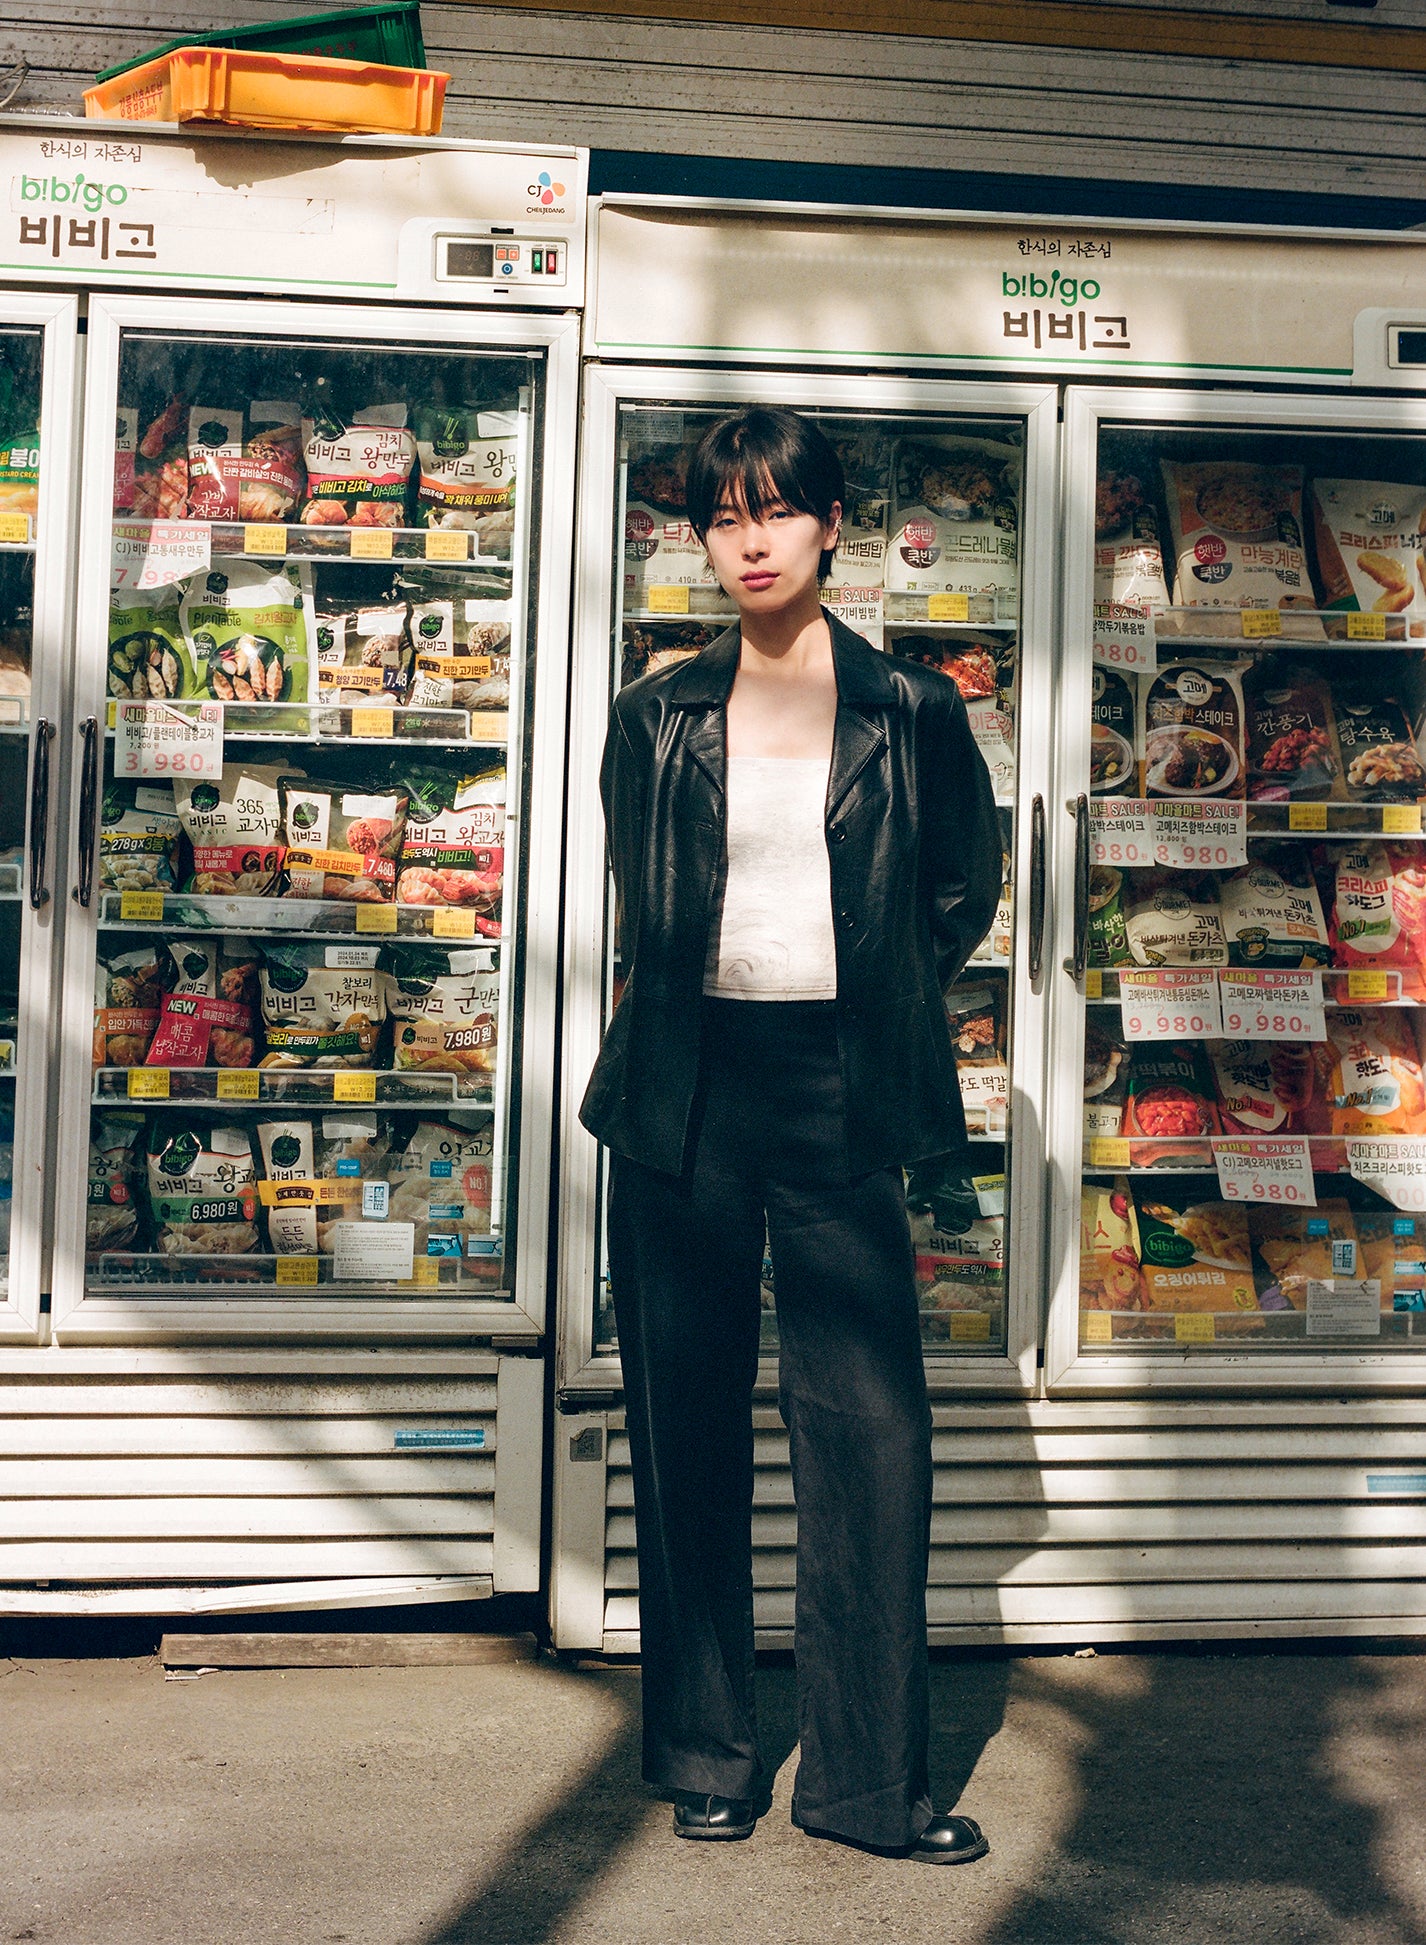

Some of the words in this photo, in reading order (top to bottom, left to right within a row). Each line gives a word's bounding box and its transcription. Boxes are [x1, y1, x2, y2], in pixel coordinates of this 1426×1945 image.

[40, 141, 87, 160] 한식의
[95, 144, 142, 163] 자존심
[21, 173, 128, 213] bibigo
[527, 185, 542, 198] CJ
[526, 207, 566, 215] CHEILJEDANG
[19, 215, 157, 261] 비비고
[1016, 238, 1061, 257] 한식의
[1067, 241, 1111, 259] 자존심
[1002, 269, 1101, 307] bibigo
[1003, 309, 1131, 351] 비비고
[375, 433, 403, 449] 김치
[436, 438, 466, 449] bibigo
[308, 444, 351, 462] 비비고
[360, 446, 410, 470] 왕만두
[431, 459, 477, 478] 비비고
[201, 490, 225, 505] 갈비
[1370, 509, 1396, 525] 고메
[113, 527, 150, 538] 새마을
[157, 528, 209, 542] 특가세일
[907, 525, 936, 542] 햇반
[1340, 531, 1398, 551] 크리스피
[907, 548, 936, 566] 쿡반
[1197, 543, 1223, 559] 햇반
[1200, 565, 1226, 580] 쿡반
[202, 595, 230, 606] 비비고
[843, 589, 880, 603] SALE!
[416, 641, 448, 653] 비비고
[460, 666, 490, 677] 고기만두
[351, 675, 381, 687] 고기만두
[1182, 679, 1207, 694] 고메
[1195, 709, 1235, 727] 스테이크
[1256, 712, 1314, 736] 깐풍기
[1340, 725, 1396, 746] 탕수육
[126, 753, 205, 774] 3,980
[236, 798, 264, 815] 365
[1111, 803, 1146, 817] SALE!
[1154, 802, 1203, 818] 새마을마트
[1205, 805, 1240, 819] SALE!
[189, 814, 227, 828] 비비고
[470, 812, 497, 828] 김치
[1156, 820, 1238, 836] 고메치즈함박스테이크
[1094, 843, 1139, 861] 980
[1156, 844, 1228, 865] 8,980
[314, 858, 330, 869] 진한
[330, 860, 361, 873] 김치만두
[367, 858, 394, 878] 7,480
[1346, 854, 1370, 870] 고메
[1338, 876, 1389, 895] 크리스피
[1287, 895, 1312, 914] 고메
[1092, 912, 1125, 934] 바삭한
[1193, 914, 1220, 930] 고메
[1284, 908, 1318, 926] 돈카츠
[1341, 919, 1367, 939] No.1
[1187, 930, 1224, 947] 돈카츠
[343, 977, 373, 989] 찰보리
[1123, 973, 1159, 984] 새마을
[1163, 973, 1212, 984] 특가세일
[1223, 973, 1258, 984] 새마을
[1263, 973, 1312, 985] 특가세일
[166, 999, 197, 1015] NEW
[265, 995, 317, 1013] 비비고
[396, 998, 444, 1014] 비비고
[1128, 1016, 1203, 1035] 9,980
[1228, 1013, 1303, 1034] 9,980
[1345, 1088, 1373, 1108] No.1
[1216, 1143, 1251, 1154] 새마을
[1257, 1144, 1304, 1155] 특가세일
[1350, 1143, 1400, 1159] 새마을마트
[164, 1154, 193, 1164] bibigo
[271, 1169, 306, 1180] 비비고
[157, 1178, 204, 1195] 비비고
[1225, 1182, 1298, 1200] 5,980
[191, 1200, 239, 1221] 6,980원
[930, 1238, 981, 1256] 비비고
[1148, 1239, 1190, 1254] bibigo
[1153, 1270, 1226, 1287] 오징어튀김
